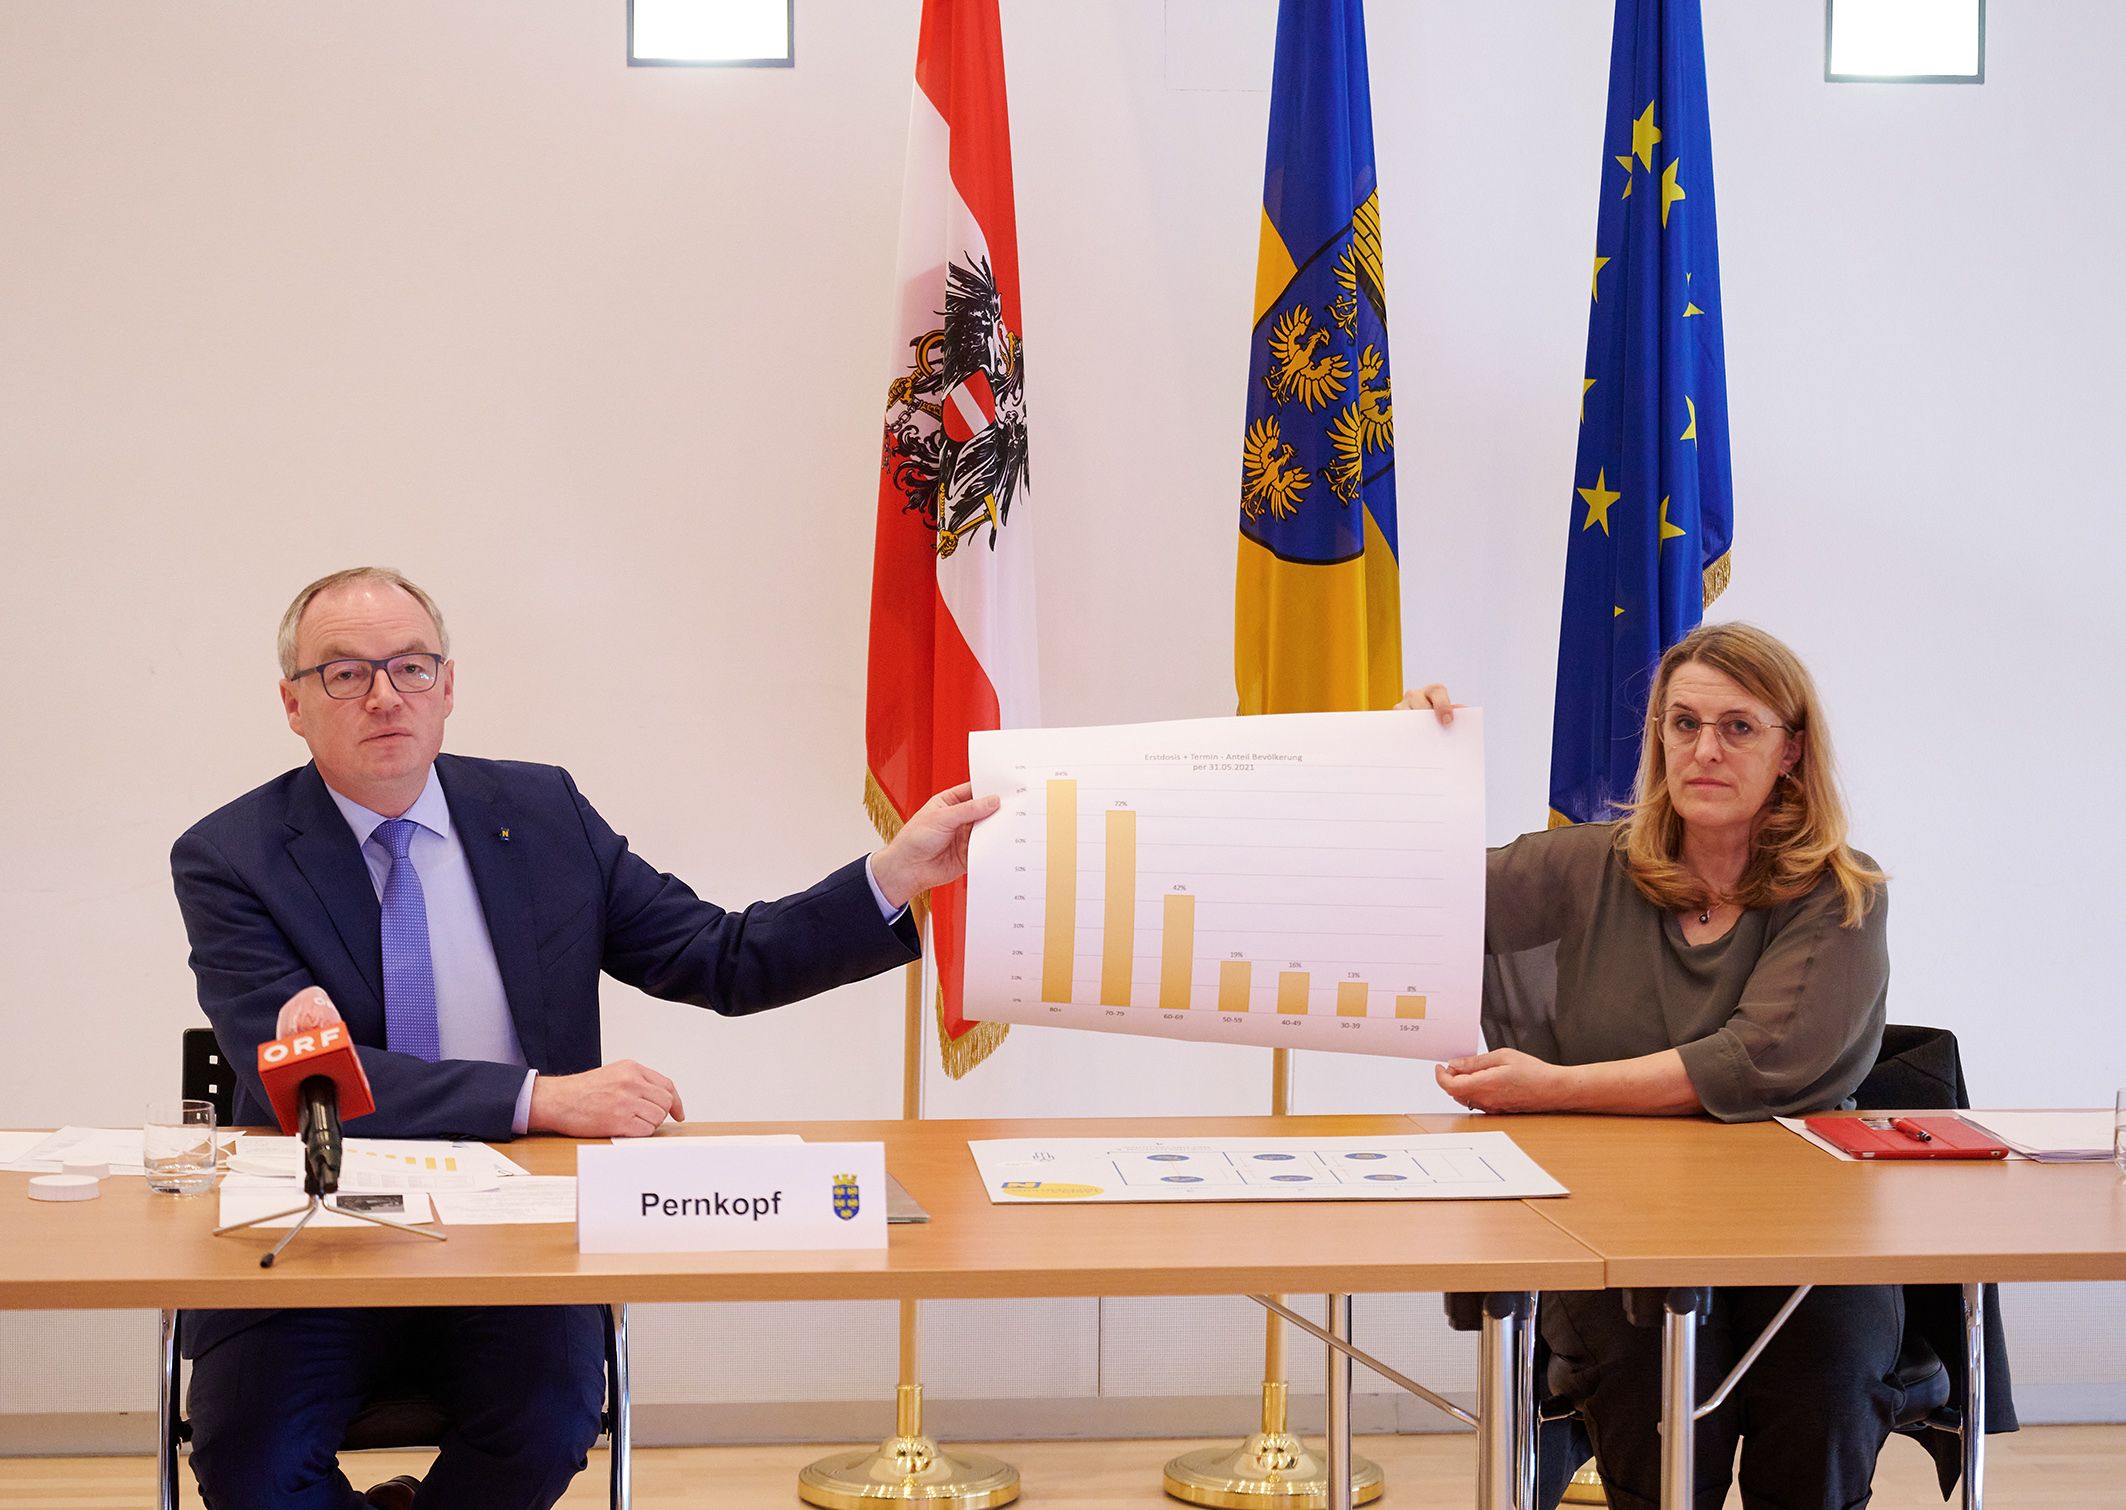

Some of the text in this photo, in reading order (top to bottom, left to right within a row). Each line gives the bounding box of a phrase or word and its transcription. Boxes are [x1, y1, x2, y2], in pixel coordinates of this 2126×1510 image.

[1144, 753, 1181, 761] Erstdosis
[1191, 753, 1219, 761] Termin
[1226, 753, 1250, 761] Anteil
[1252, 753, 1303, 763] Bevölkerung
[1193, 763, 1254, 772] per 31.05.2021
[1399, 1024, 1420, 1032] 16-29
[263, 1027, 340, 1063] ORF
[640, 1191, 782, 1221] Pernkopf
